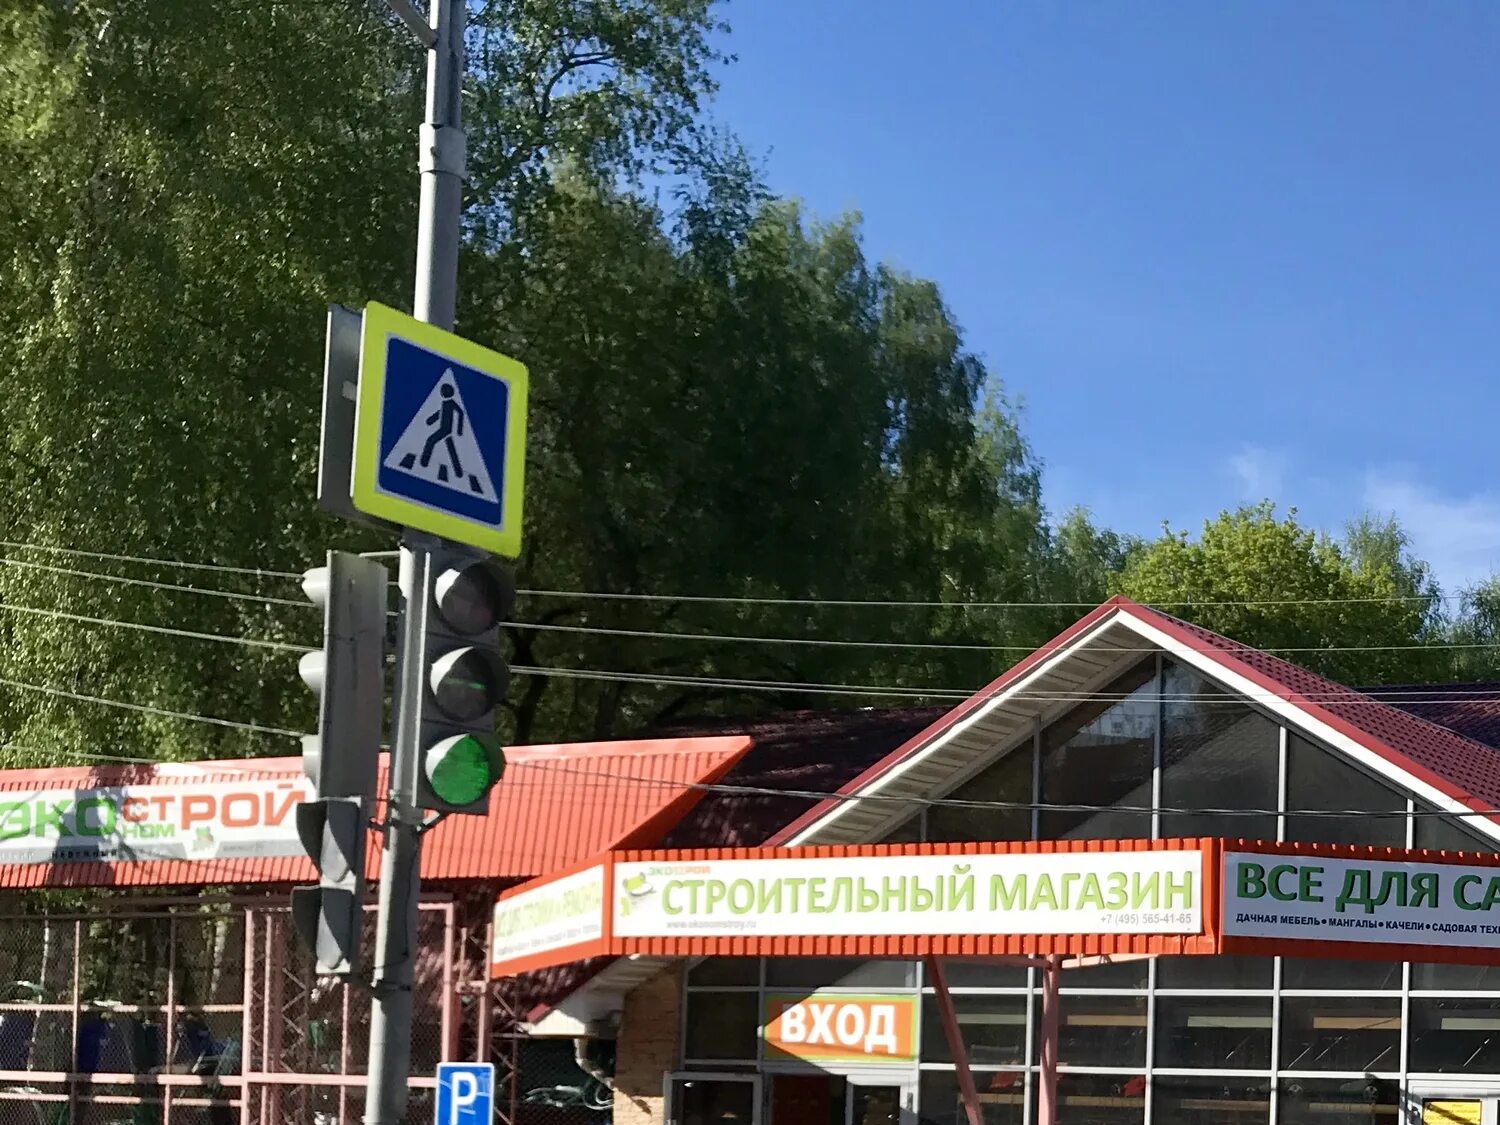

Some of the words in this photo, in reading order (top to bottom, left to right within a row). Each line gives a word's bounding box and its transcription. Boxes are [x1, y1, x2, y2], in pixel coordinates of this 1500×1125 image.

[662, 864, 975, 915] СТРОИТЕЛЬНЫЙ
[989, 871, 1193, 911] МАГАЗИН
[1236, 862, 1324, 902] ВСЕ
[1335, 869, 1439, 914] ДЛЯ
[1100, 914, 1112, 924] +7
[1115, 914, 1139, 926] (495)
[1142, 913, 1192, 924] 565-41-65
[1236, 913, 1277, 924] ДАЧНАЯ
[1280, 915, 1321, 926] МЕБЕЛЬ
[1328, 918, 1378, 929] МАНГАЛЫ
[1385, 920, 1425, 931] КАЧЕЛИ
[1432, 923, 1477, 934] САДОВАЯ
[780, 1003, 897, 1054] ВХОД
